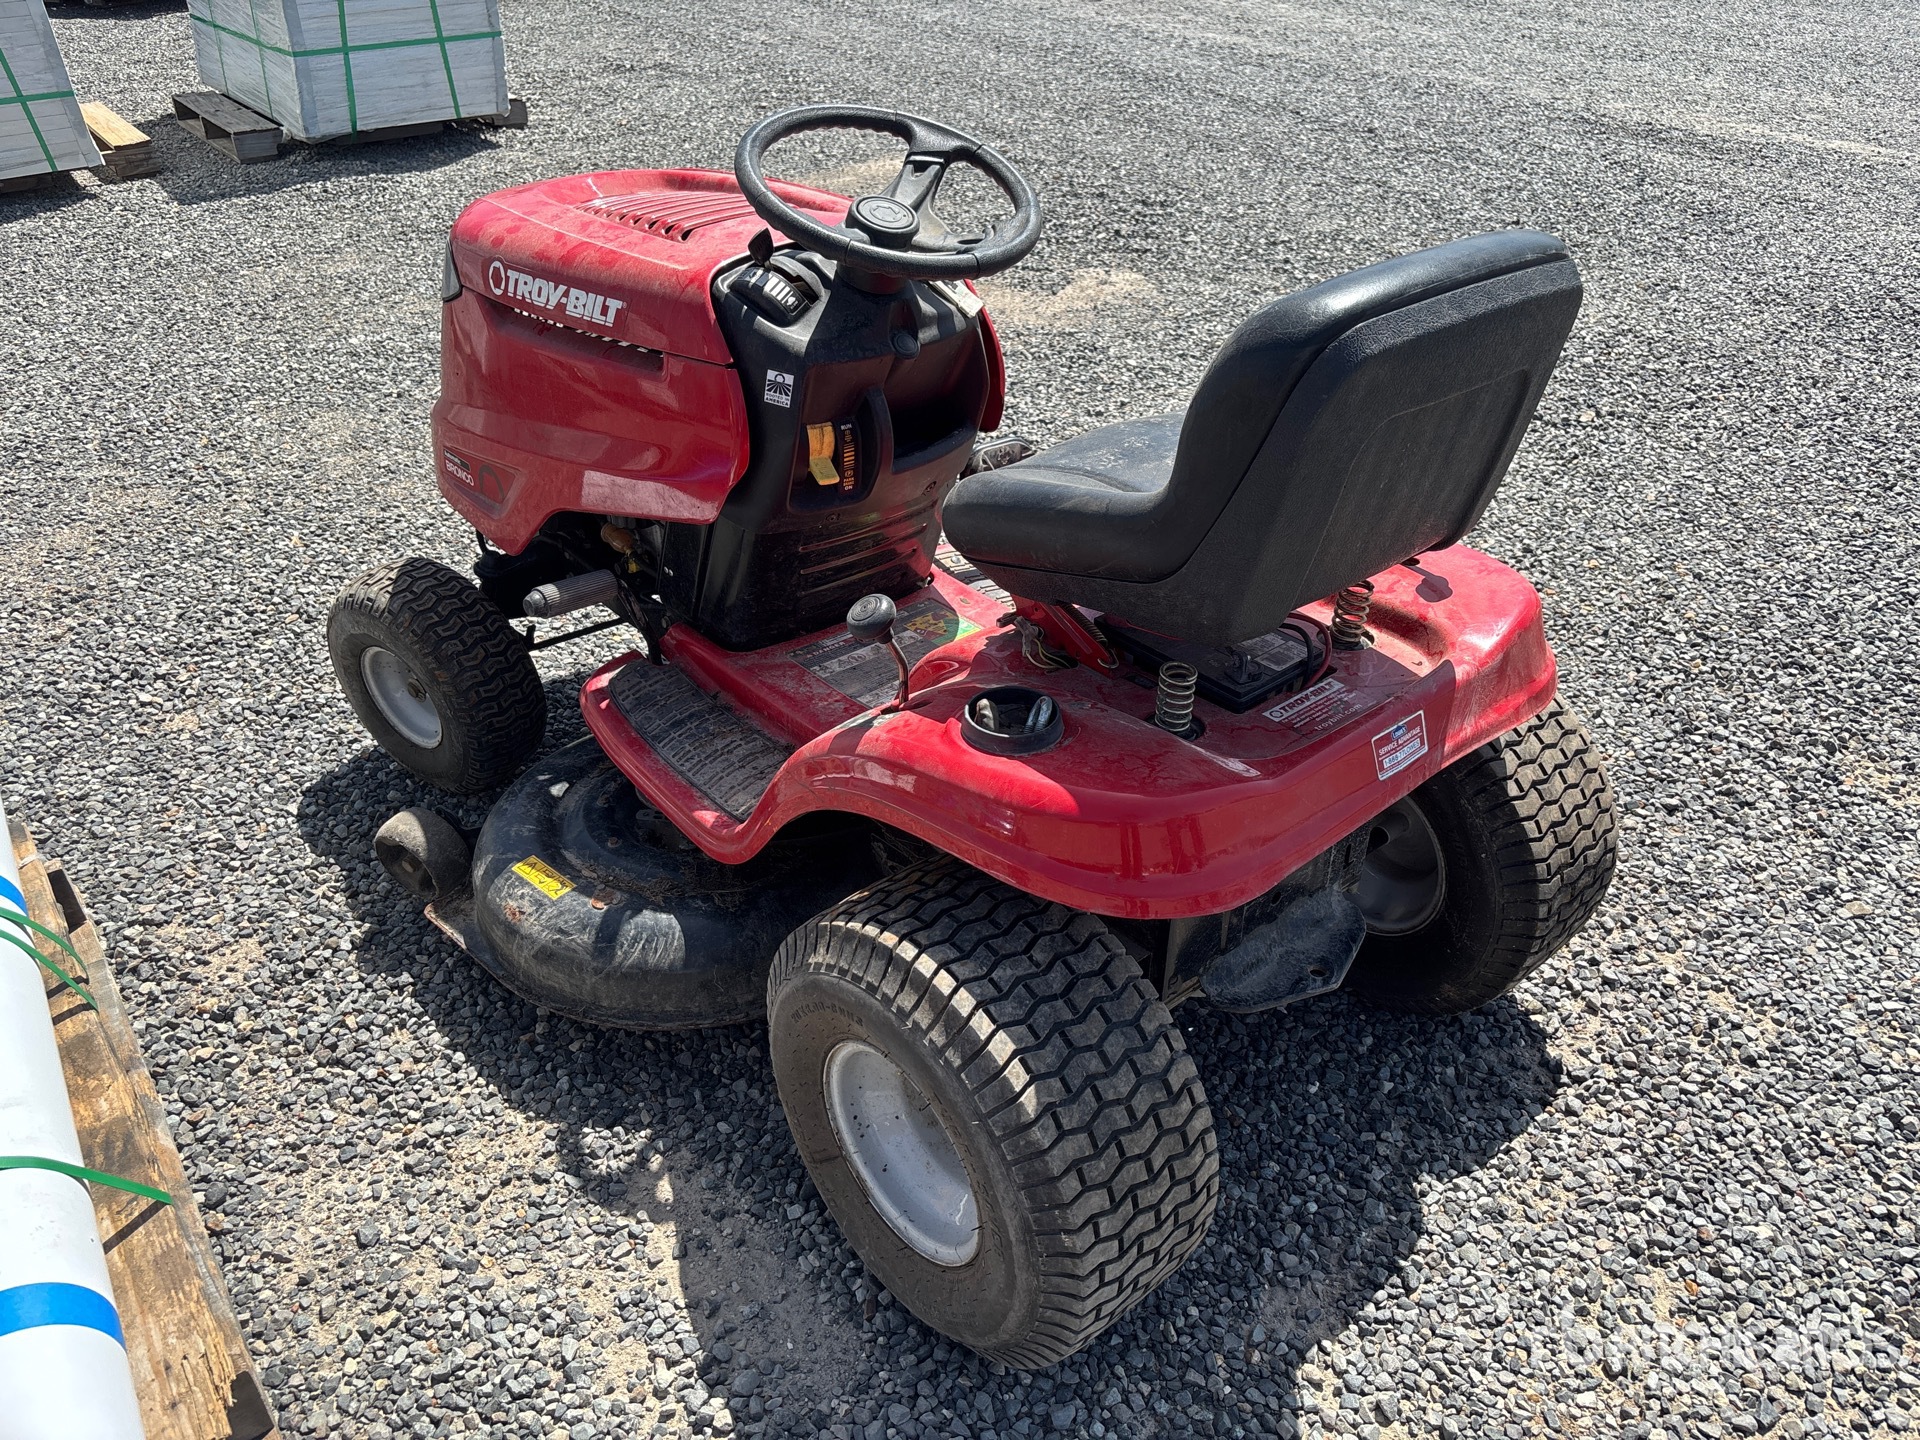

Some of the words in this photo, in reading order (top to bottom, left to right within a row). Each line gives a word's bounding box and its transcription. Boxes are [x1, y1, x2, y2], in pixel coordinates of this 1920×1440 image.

[507, 269, 623, 327] TROY-BILT
[765, 397, 789, 406] AMERICA
[766, 392, 784, 401] ROOTED
[445, 460, 475, 487] BRONCO
[1279, 681, 1334, 714] TROY-BILT
[1314, 703, 1362, 732] troybilt.com
[1378, 740, 1398, 756] SERVICE
[1398, 725, 1421, 745] ADVANTAGE
